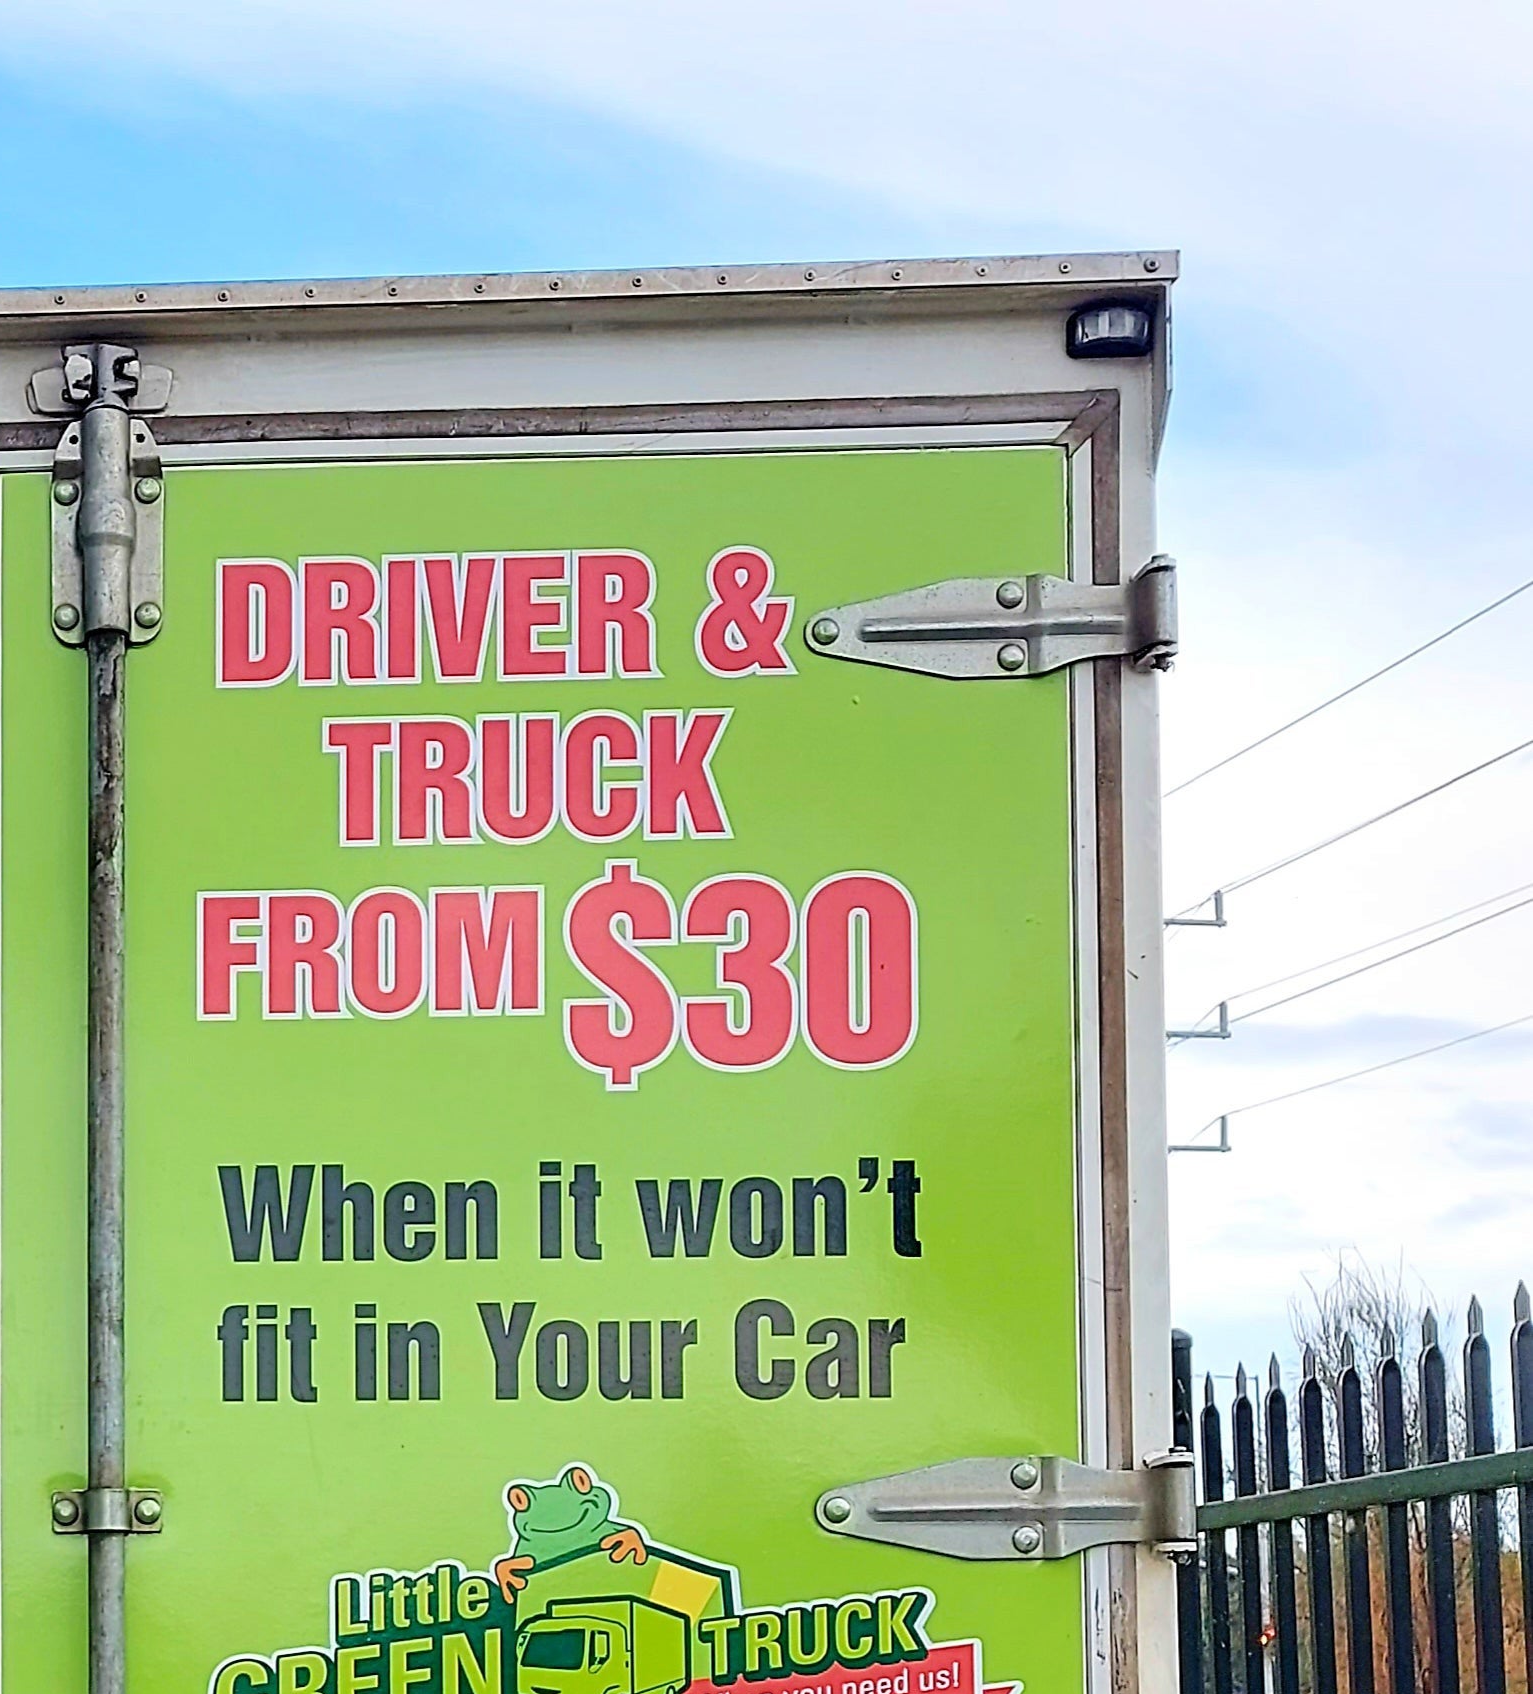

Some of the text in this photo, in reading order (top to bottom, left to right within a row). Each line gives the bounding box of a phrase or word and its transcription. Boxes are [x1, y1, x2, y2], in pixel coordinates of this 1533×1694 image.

[215, 544, 798, 688] DRIVER &
[322, 708, 734, 846] TRUCK
[196, 858, 919, 1092] FROM $30
[217, 1157, 923, 1262] When it won't
[217, 1299, 906, 1402] fit in Your Car
[336, 1565, 490, 1637] Little
[700, 1593, 920, 1677] TRUCK
[919, 1661, 960, 1692] us!
